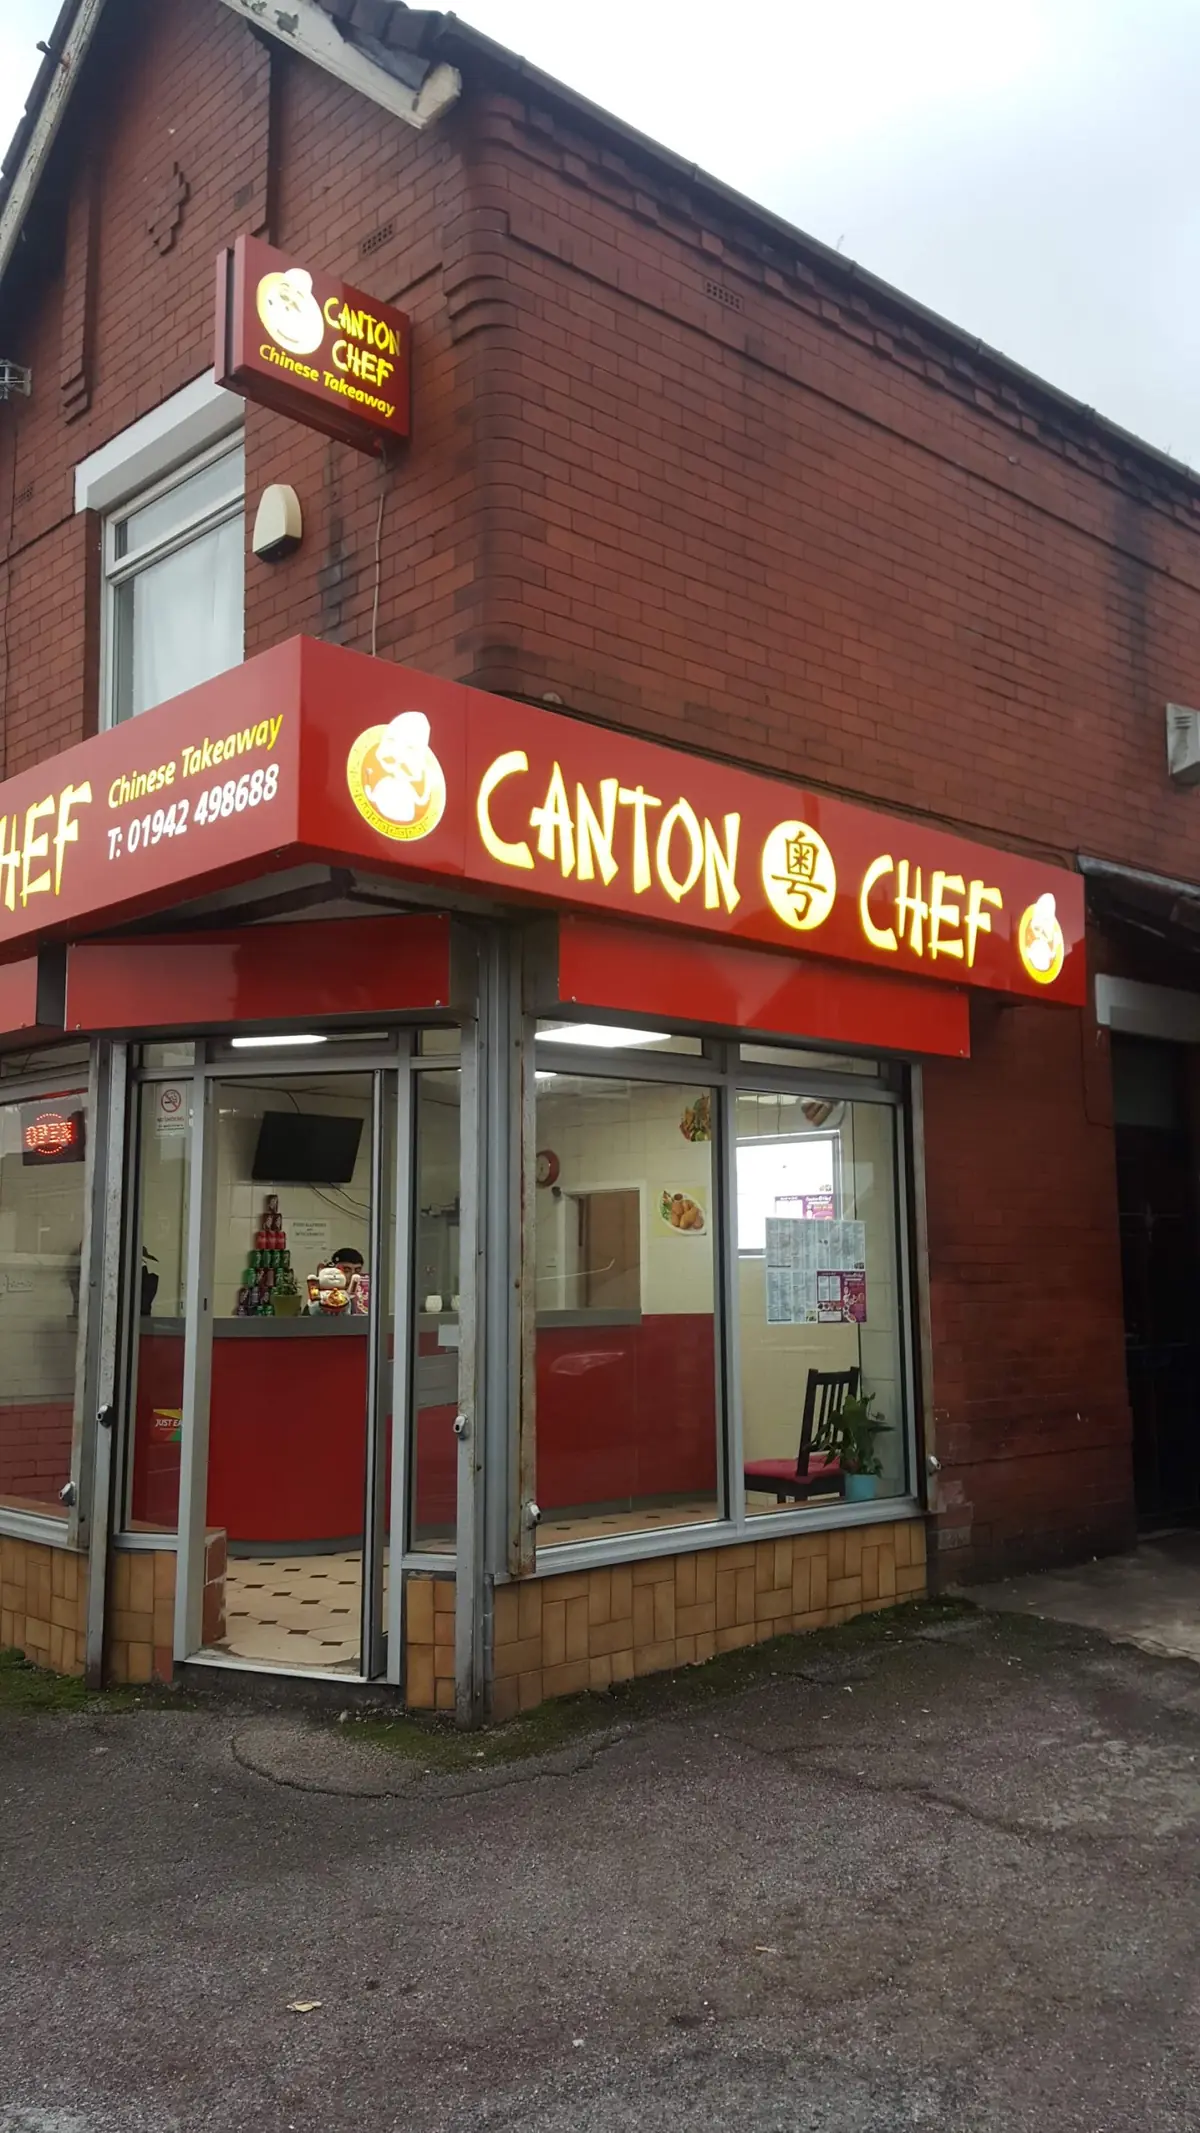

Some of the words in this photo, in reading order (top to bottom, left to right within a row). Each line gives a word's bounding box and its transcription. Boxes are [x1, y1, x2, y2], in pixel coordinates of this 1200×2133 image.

[324, 297, 400, 356] CANTON
[332, 339, 394, 386] CHEF
[259, 344, 319, 382] Chinese
[323, 371, 395, 417] Takeaway
[108, 761, 176, 808] Chinese
[182, 714, 283, 777] Takeaway
[108, 827, 123, 860] T:
[127, 799, 190, 853] 01942
[194, 763, 280, 825] 498688
[477, 750, 741, 914] CANTON
[860, 855, 1003, 968] CHEF
[26, 1122, 72, 1146] OPEN
[155, 1419, 172, 1427] JUST
